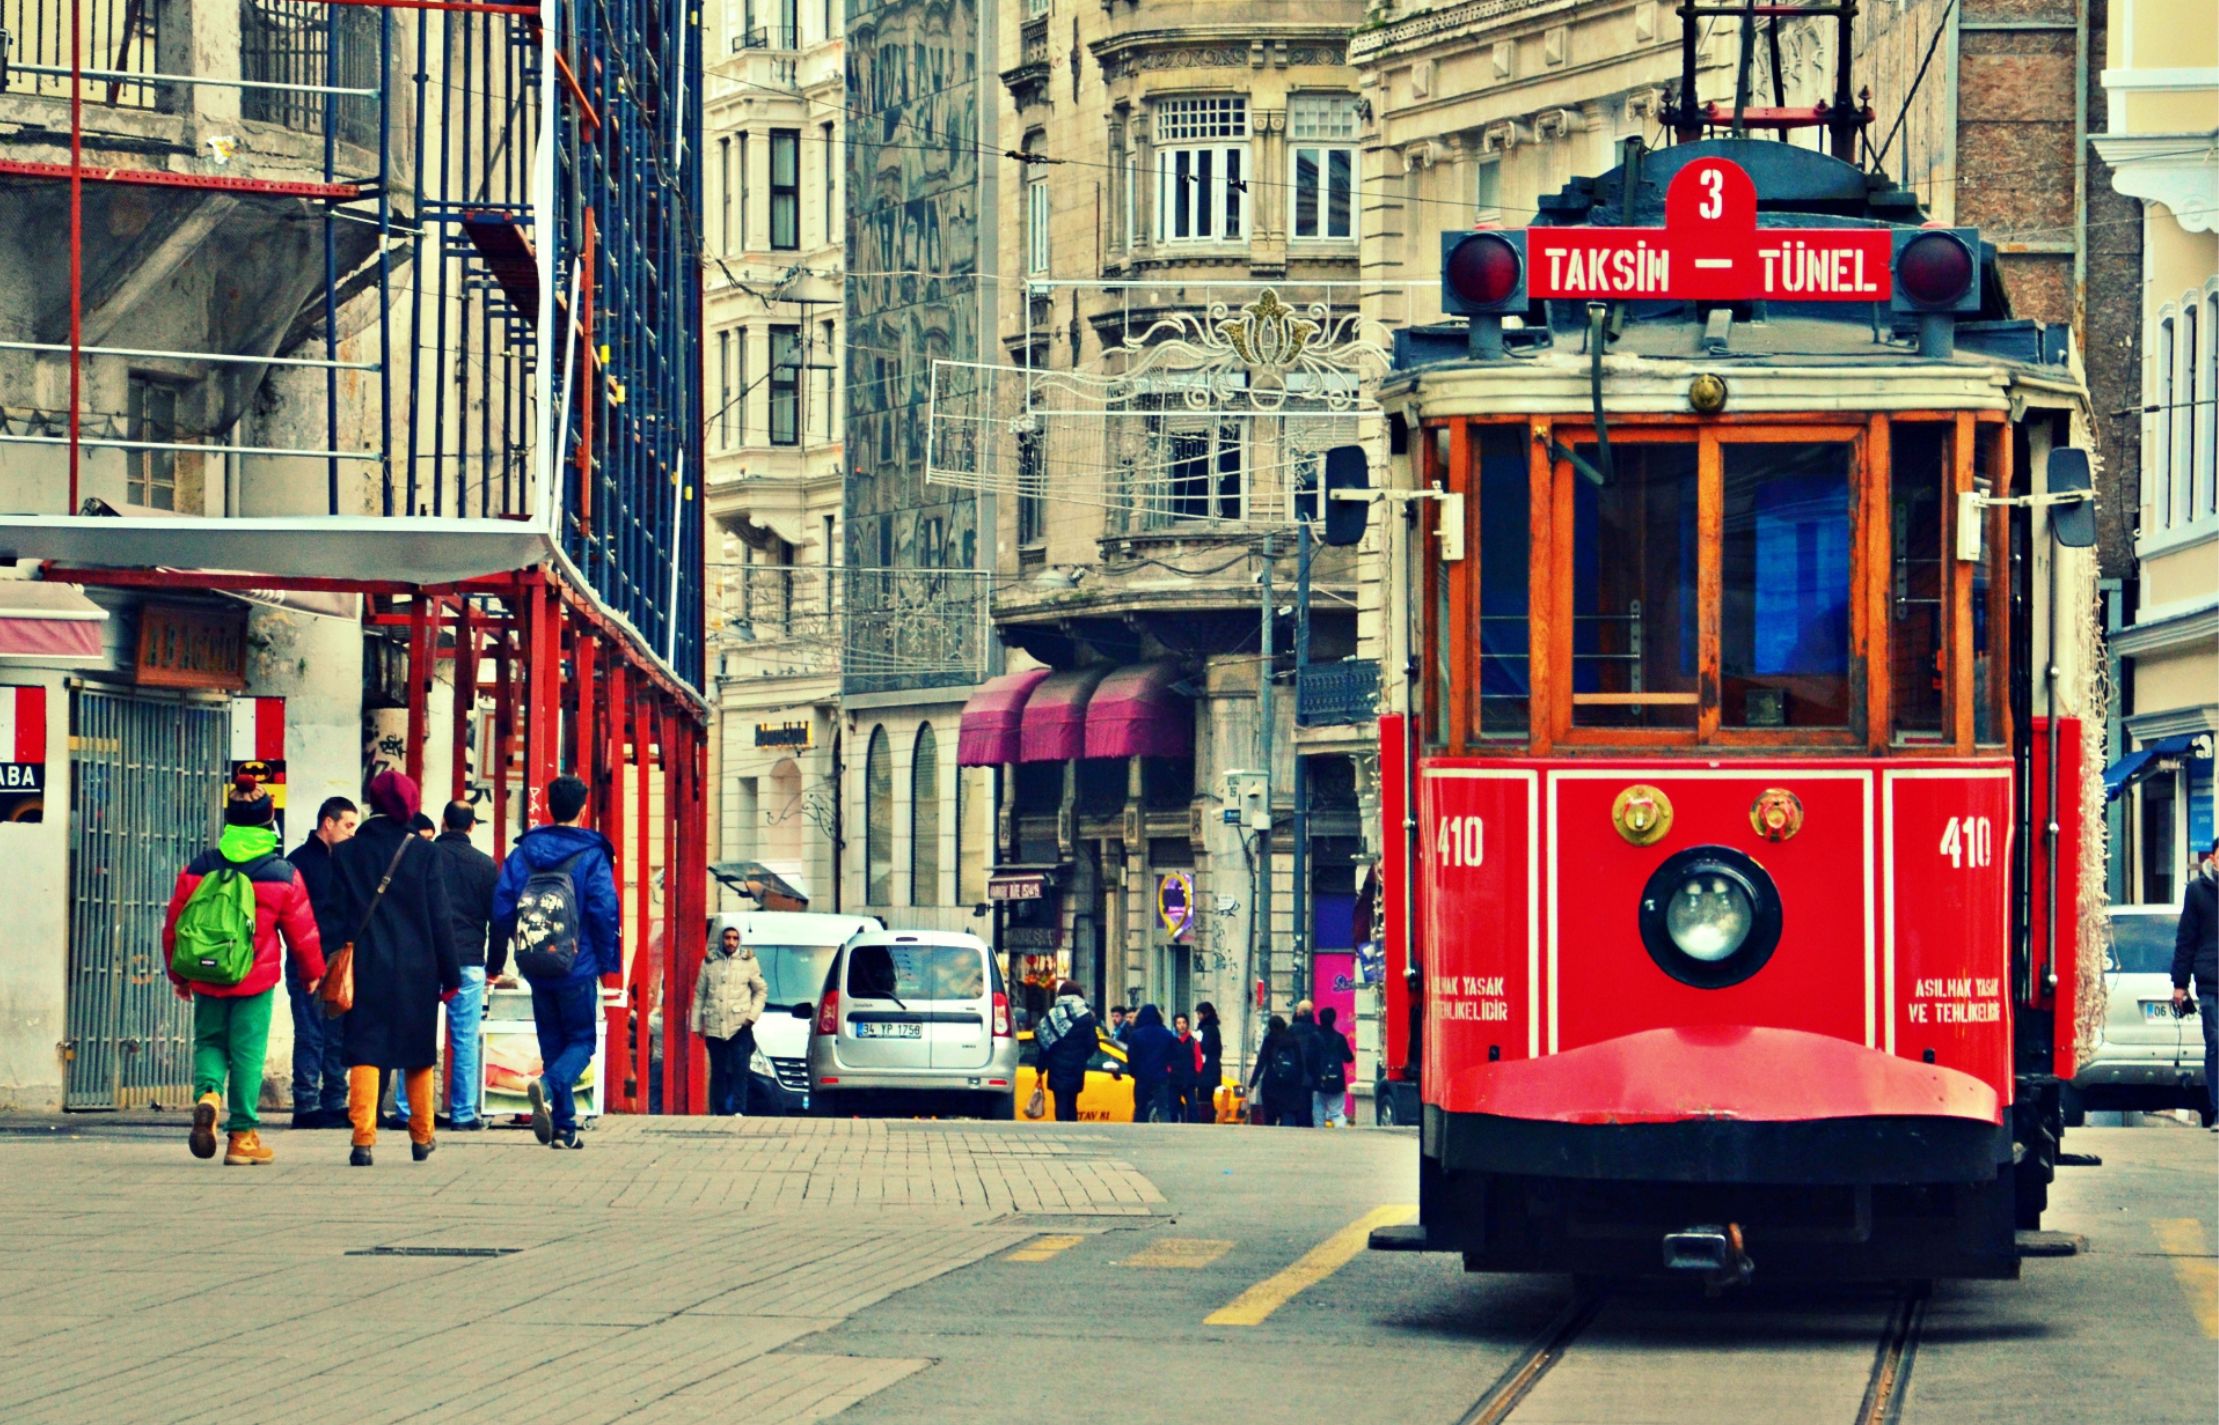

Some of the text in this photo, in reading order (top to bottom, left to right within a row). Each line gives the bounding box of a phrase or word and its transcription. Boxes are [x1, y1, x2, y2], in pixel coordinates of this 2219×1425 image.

[1699, 169, 1724, 220] 3
[1544, 240, 1670, 293] TAKSİM
[1758, 241, 1878, 293] TÜNEL
[1437, 815, 1484, 868] 410
[1939, 816, 1992, 869] 410
[1462, 976, 1504, 997] YASAK
[863, 1023, 875, 1034] 34
[1907, 1002, 1929, 1023] VE
[2153, 1005, 2168, 1017] 06
